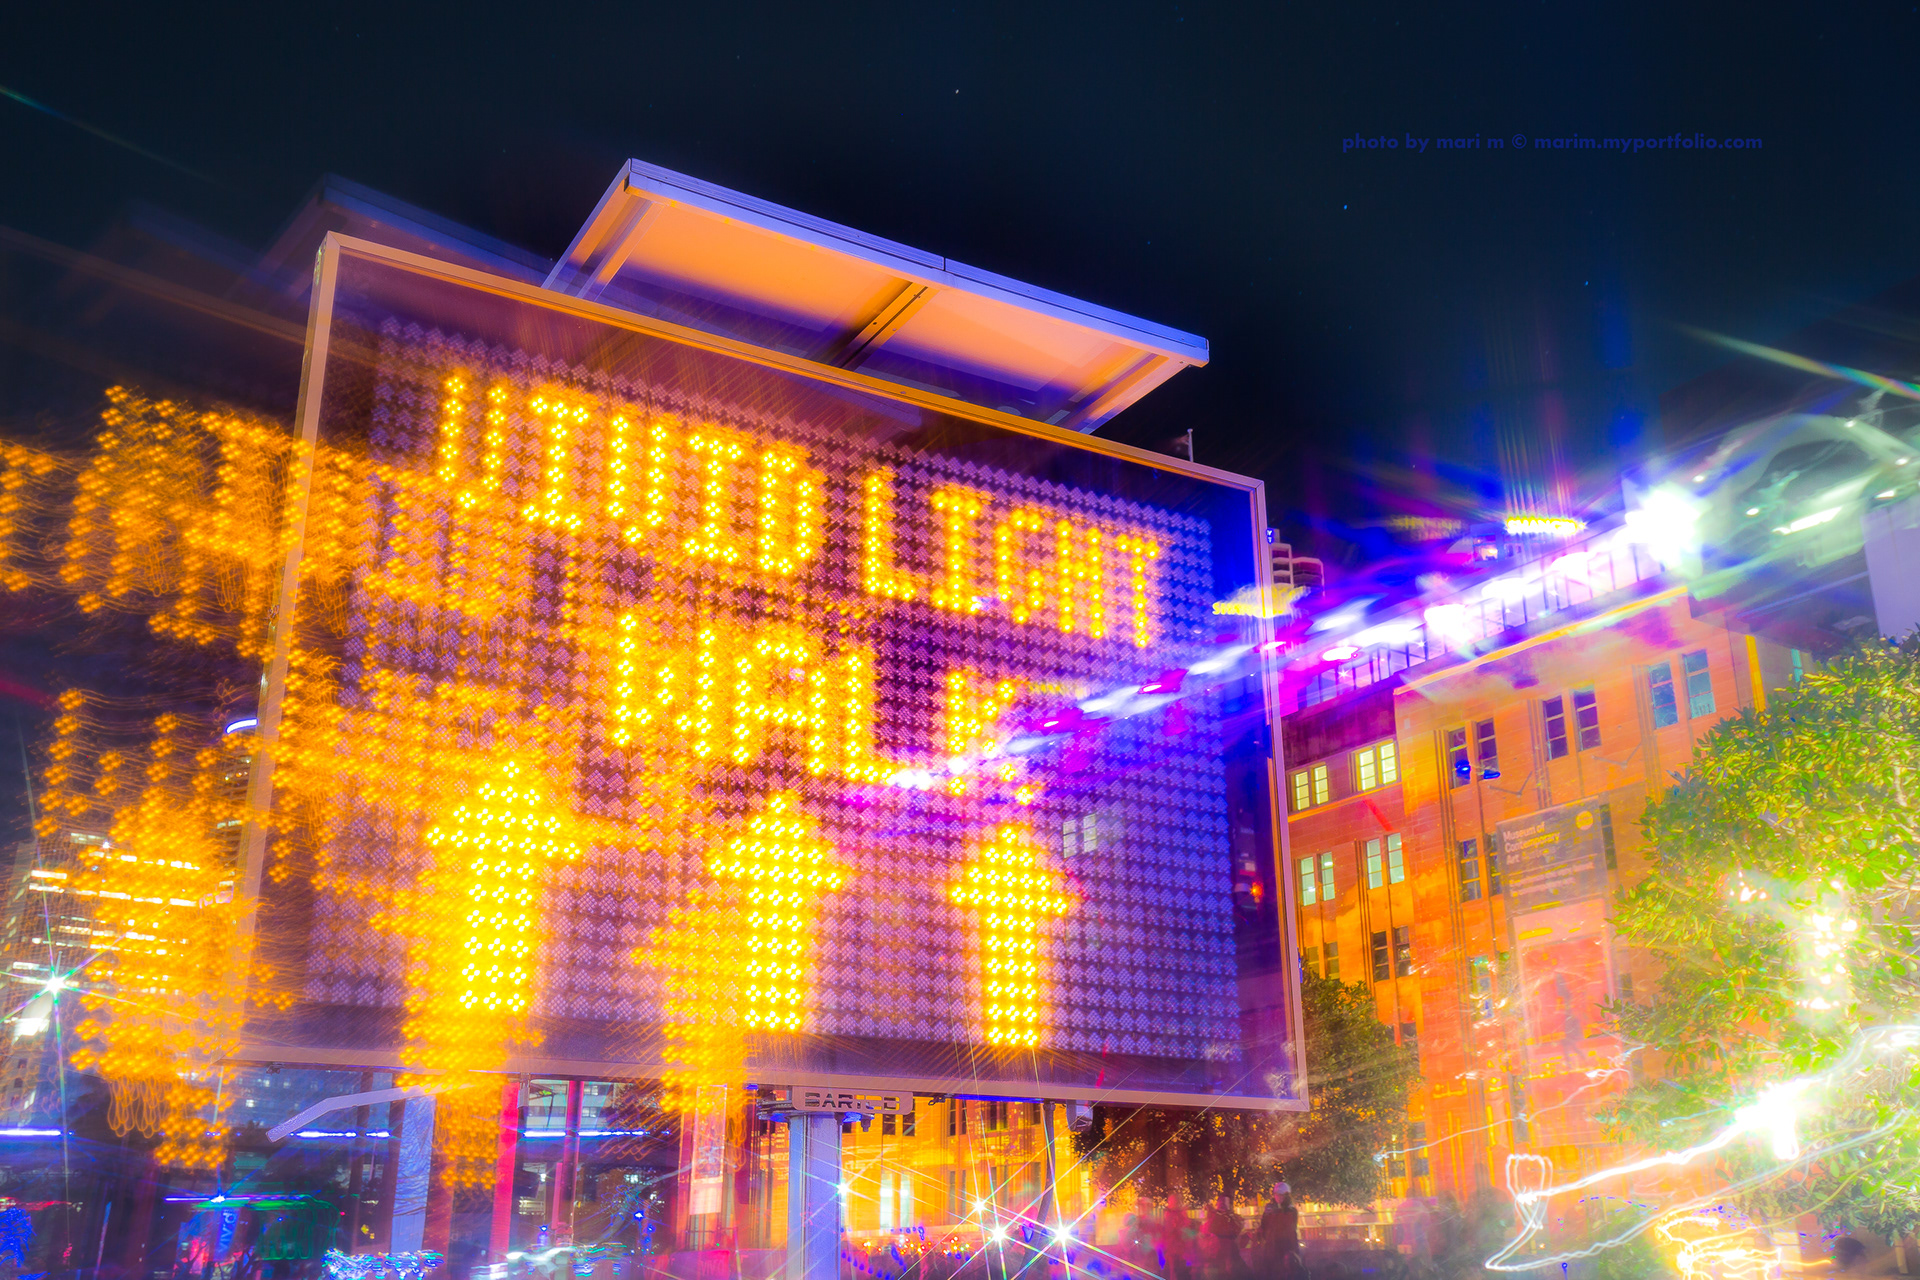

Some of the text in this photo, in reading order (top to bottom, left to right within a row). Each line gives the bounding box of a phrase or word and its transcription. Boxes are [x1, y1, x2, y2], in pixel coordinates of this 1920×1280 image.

[439, 375, 821, 577] VIVID
[864, 473, 1161, 650] LIGHT
[612, 613, 1036, 806] WALK
[1503, 826, 1536, 842] Museum
